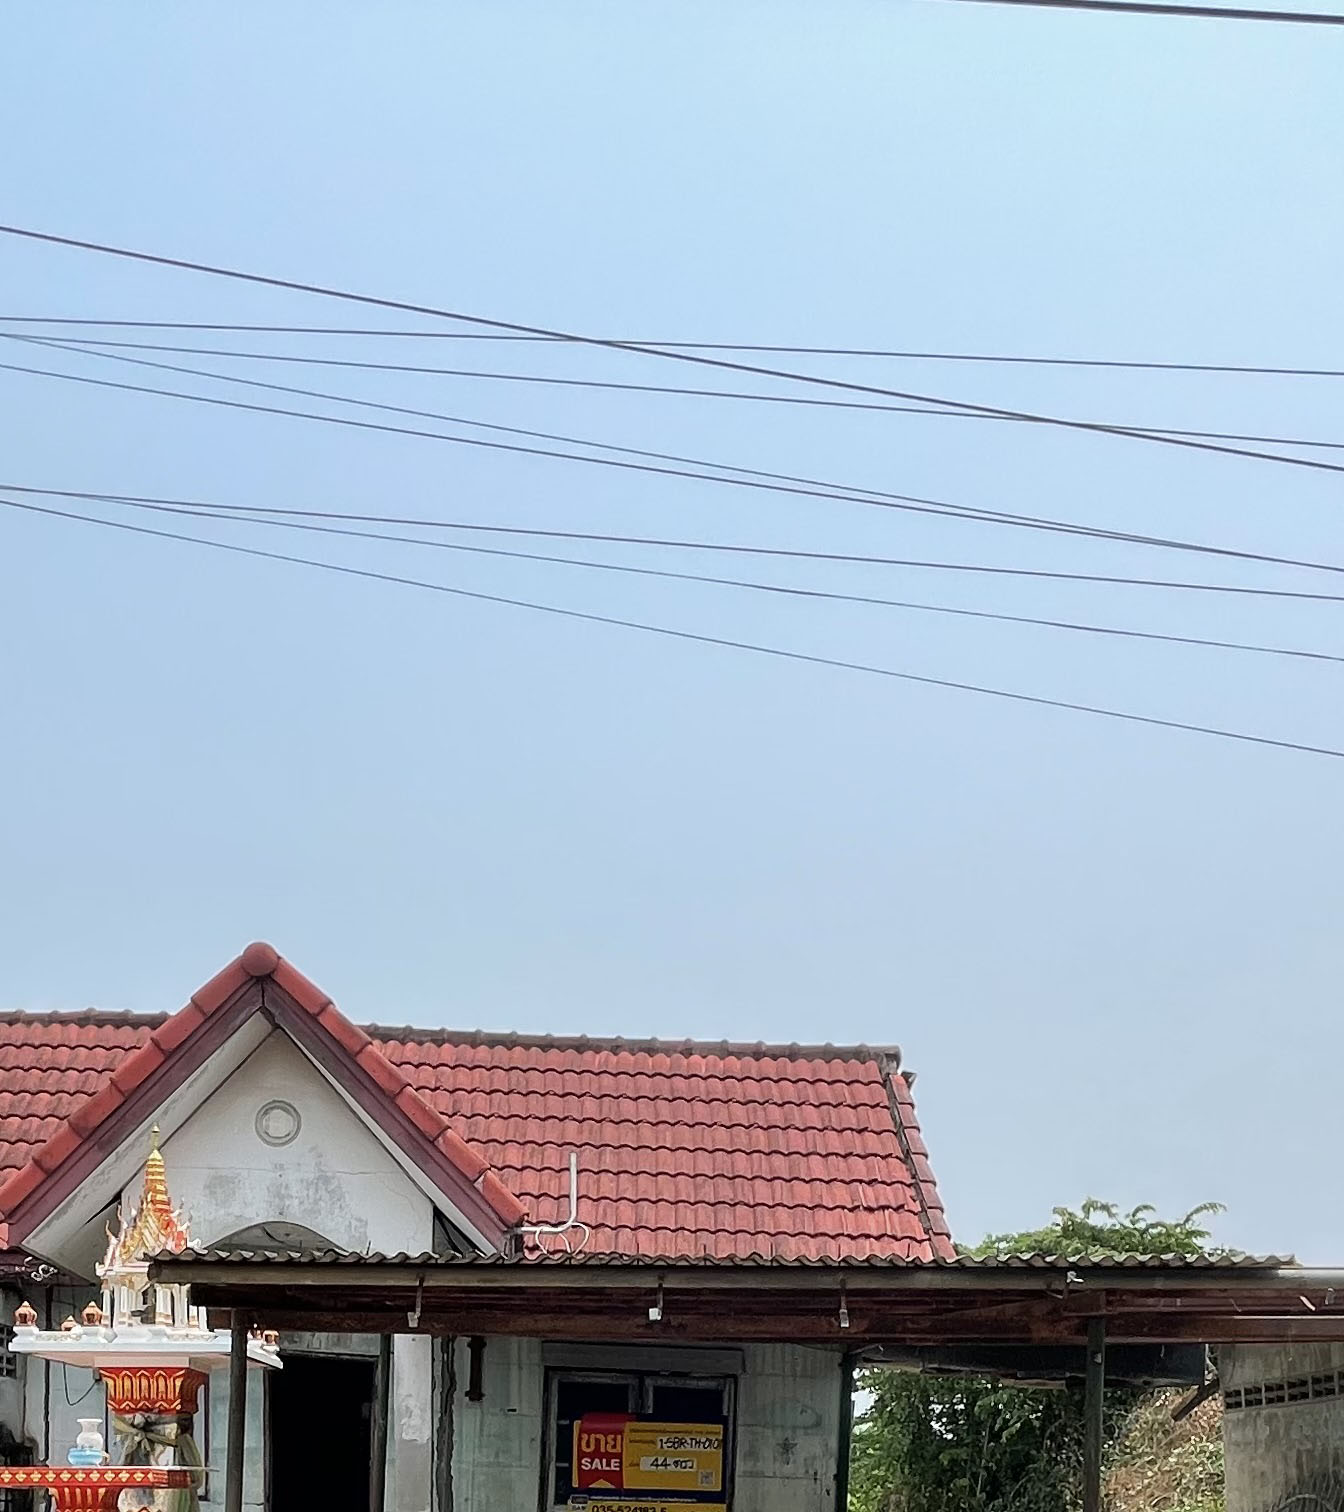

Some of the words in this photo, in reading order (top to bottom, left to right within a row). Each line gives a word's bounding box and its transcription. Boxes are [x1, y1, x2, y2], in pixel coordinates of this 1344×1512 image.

[581, 1433, 622, 1453] ขาย
[581, 1457, 621, 1471] SALE
[650, 1457, 671, 1469] 44
